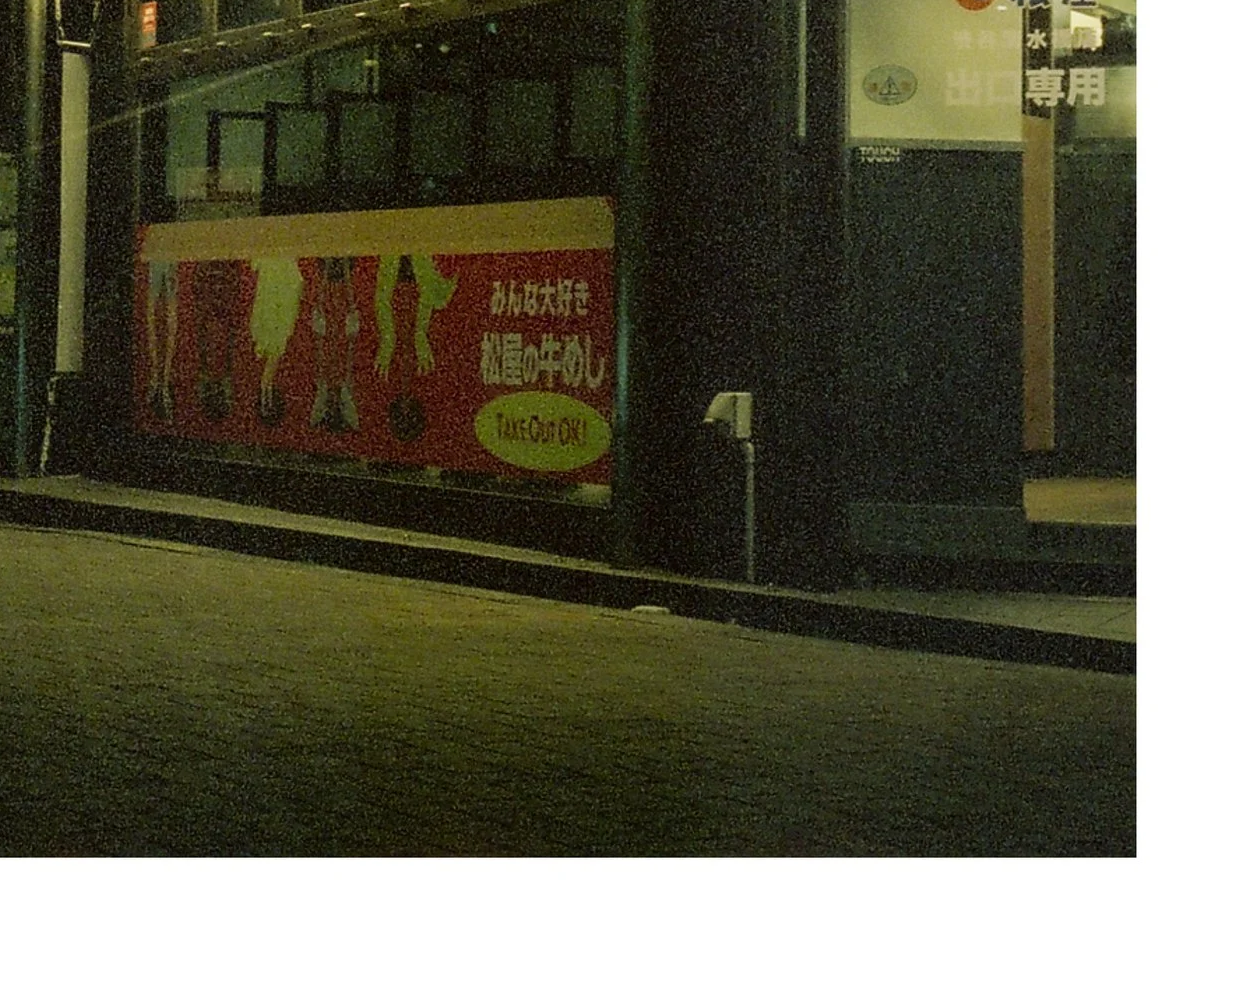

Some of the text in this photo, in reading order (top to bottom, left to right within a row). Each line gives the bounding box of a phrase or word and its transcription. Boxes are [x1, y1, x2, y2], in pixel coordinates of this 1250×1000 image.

[945, 67, 1106, 107] 出口専用
[490, 278, 590, 317] みんな大好き
[480, 332, 606, 388] 松屋の牛めし
